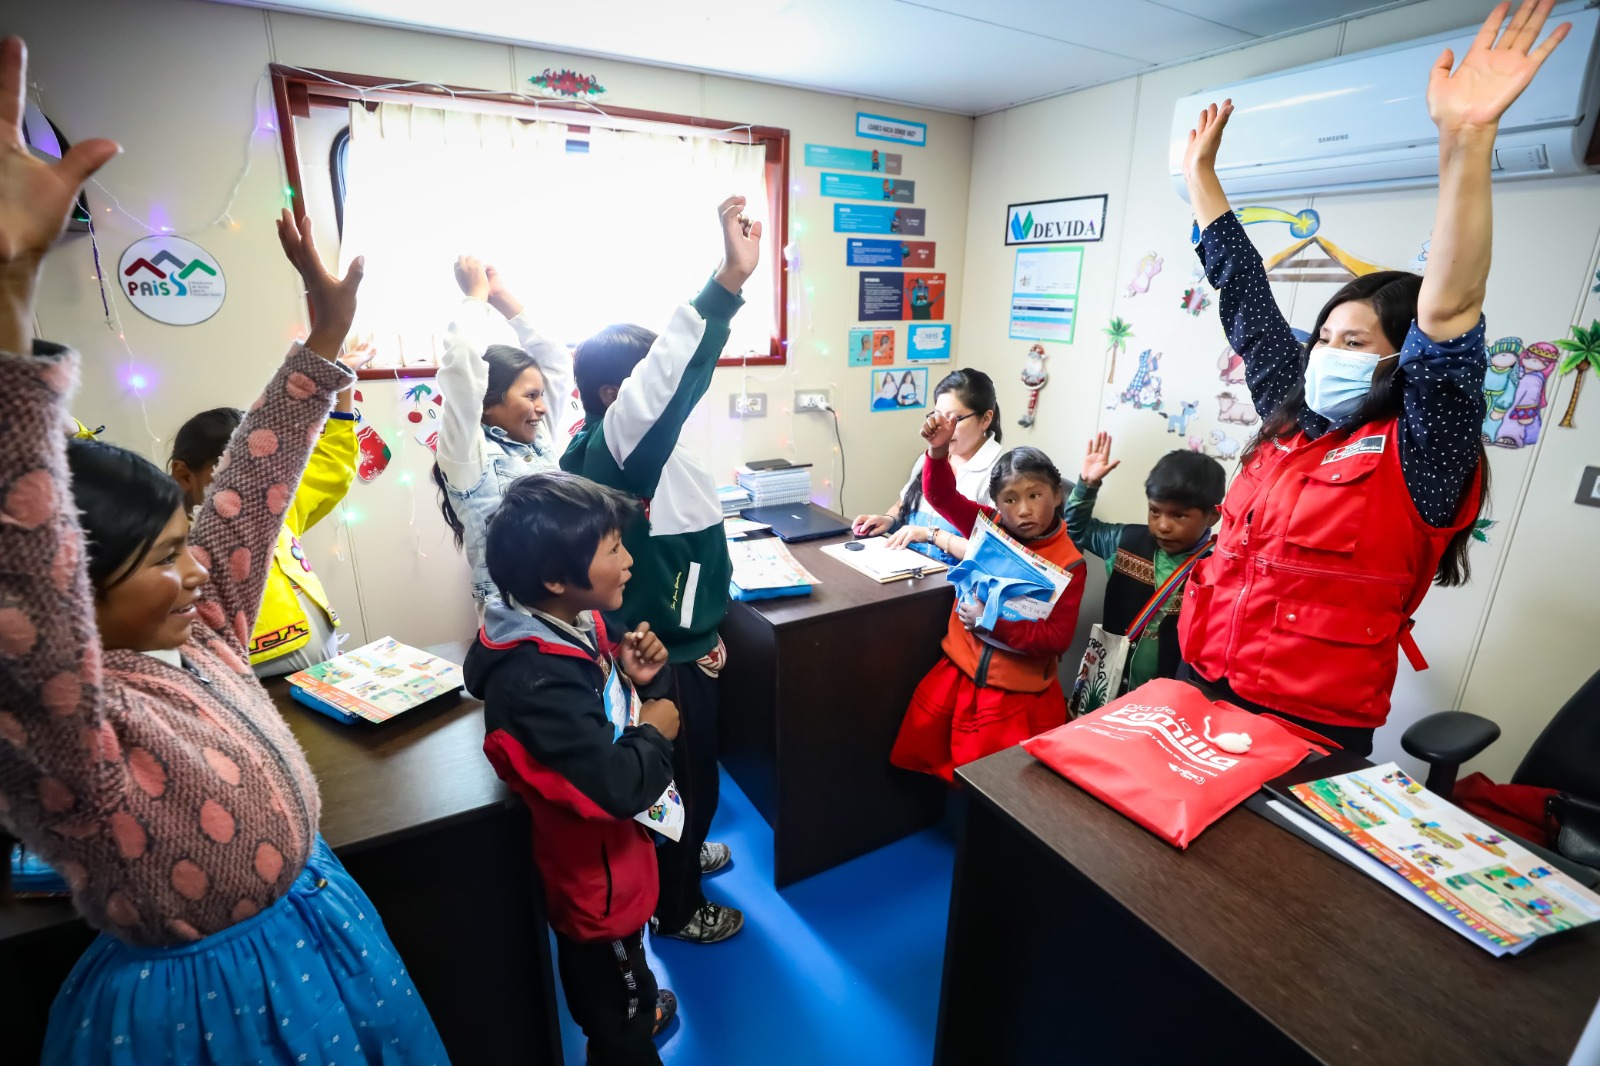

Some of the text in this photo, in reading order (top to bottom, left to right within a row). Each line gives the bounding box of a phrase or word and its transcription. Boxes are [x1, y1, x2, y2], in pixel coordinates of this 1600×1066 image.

[1318, 133, 1349, 143] SAMSUNG
[1033, 219, 1096, 239] DEVIDA
[1154, 704, 1178, 717] de
[1177, 717, 1192, 733] la
[1109, 707, 1241, 769] Familia
